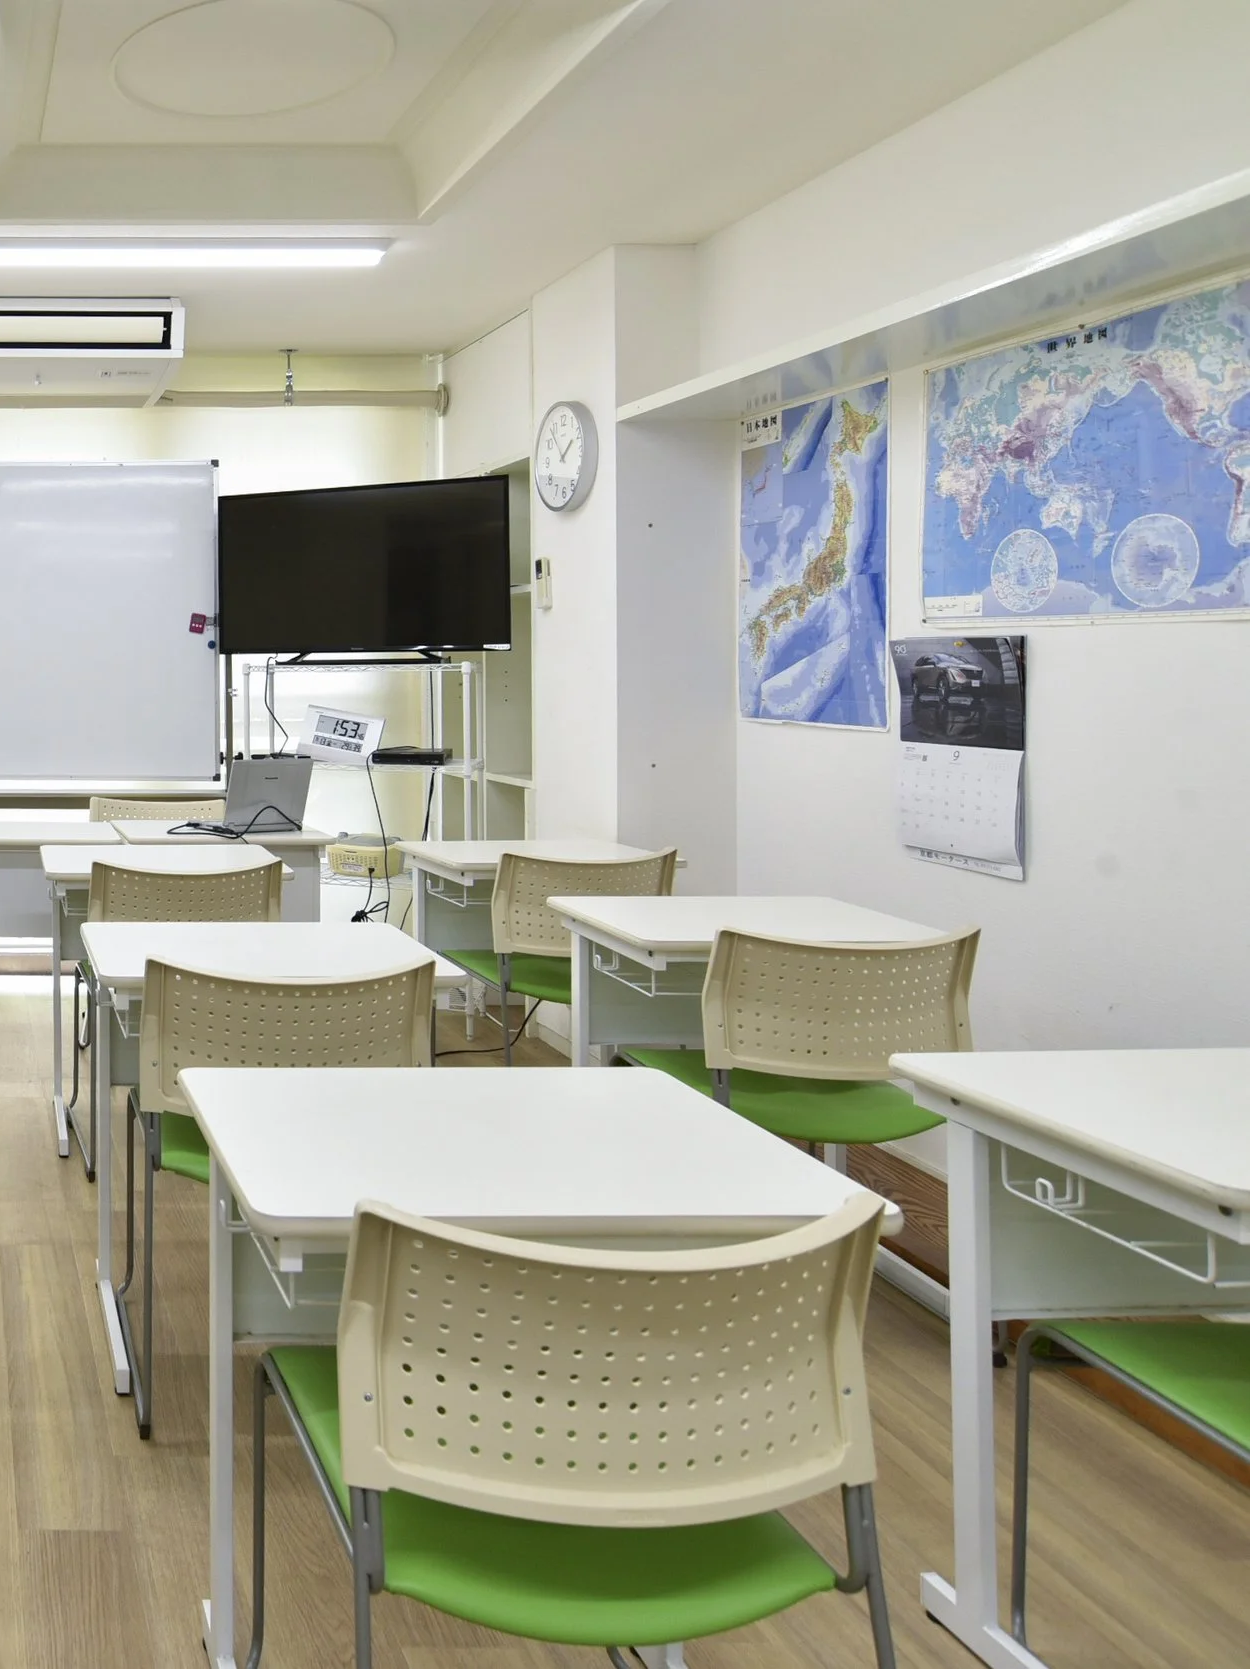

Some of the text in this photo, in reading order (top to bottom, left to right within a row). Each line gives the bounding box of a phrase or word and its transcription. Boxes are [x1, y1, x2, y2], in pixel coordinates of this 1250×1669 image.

[1047, 327, 1108, 353] 世界地図
[560, 414, 567, 427] 12
[746, 415, 778, 434] 日本地図
[952, 750, 961, 761] 9
